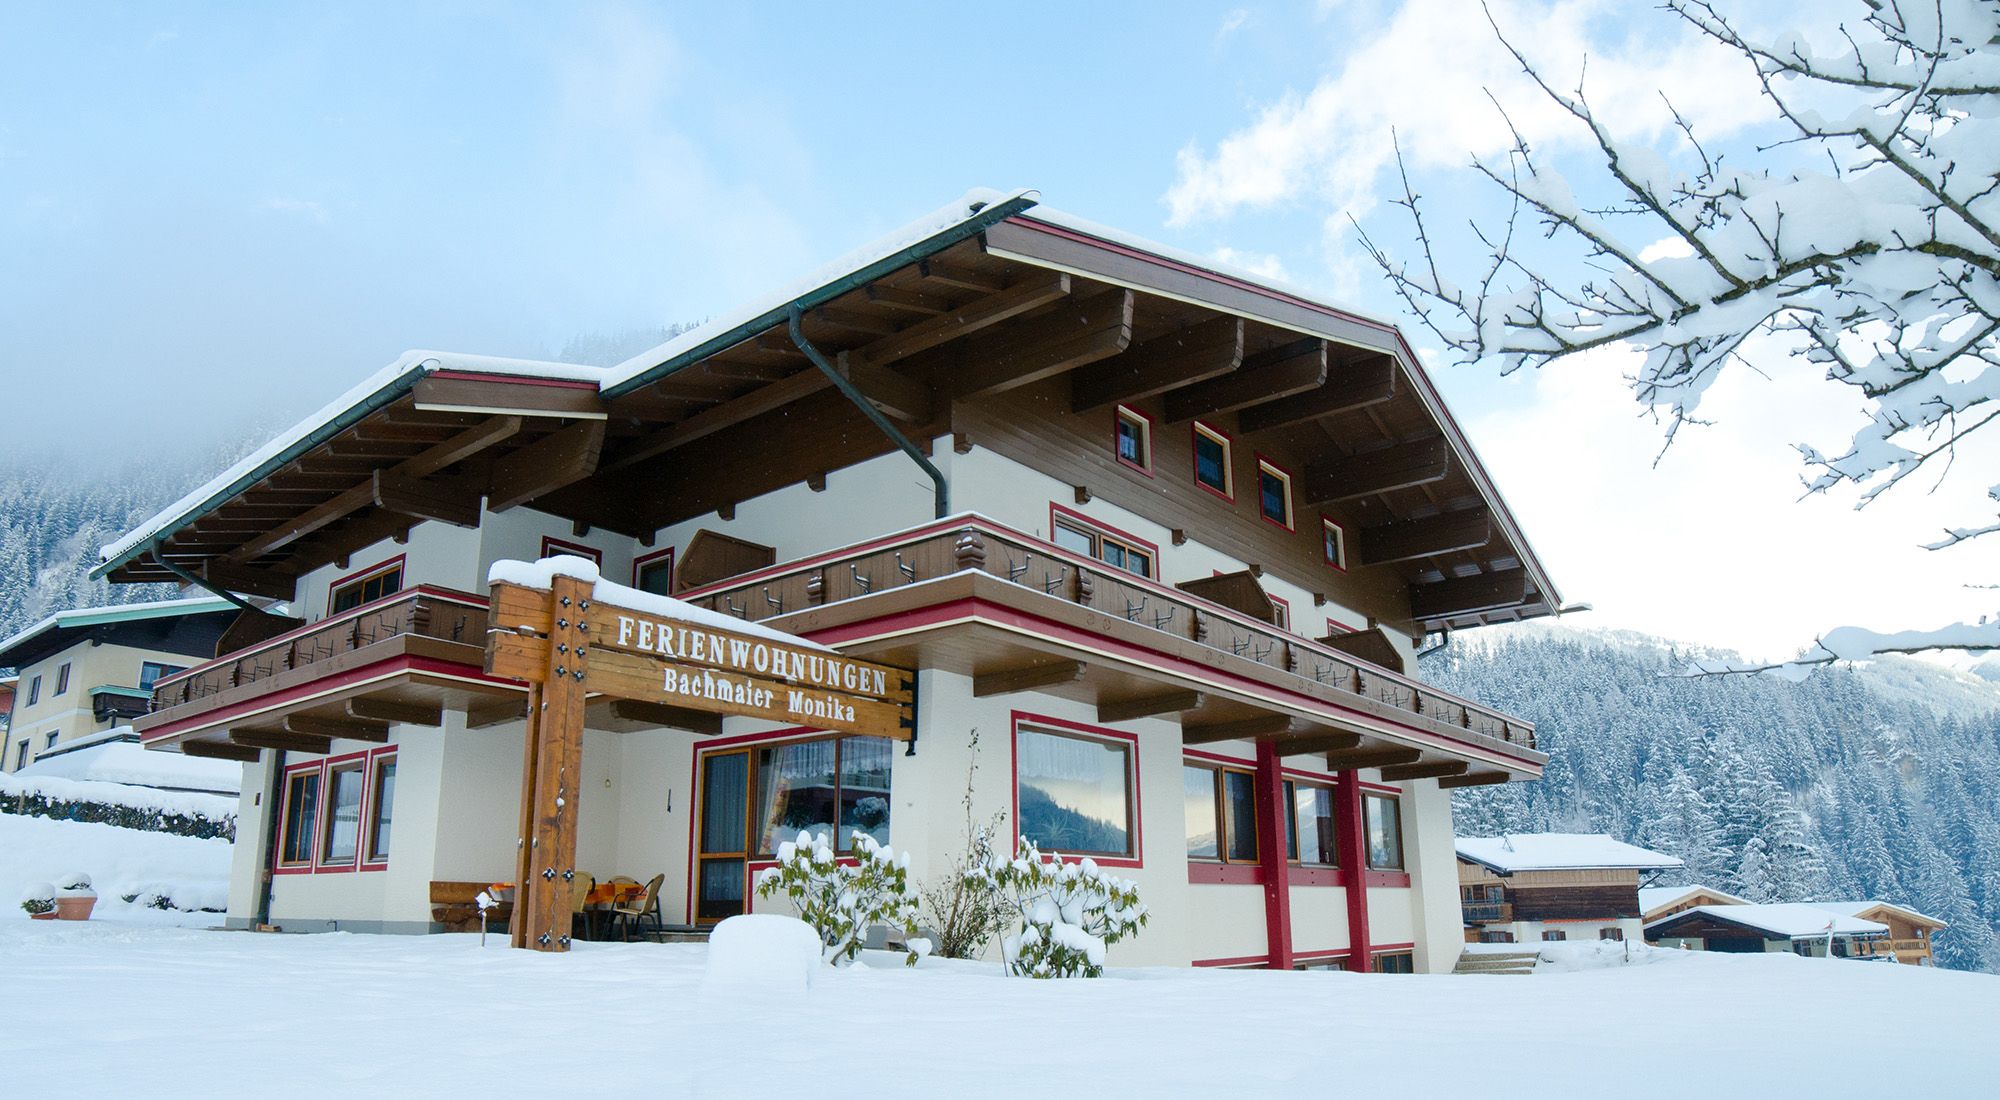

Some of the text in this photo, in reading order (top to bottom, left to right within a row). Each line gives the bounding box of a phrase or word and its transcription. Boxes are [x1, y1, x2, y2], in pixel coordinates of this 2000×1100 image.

[617, 616, 886, 695] FERIENWOHNUNGEN
[663, 668, 856, 722] Bachmaier Monika
